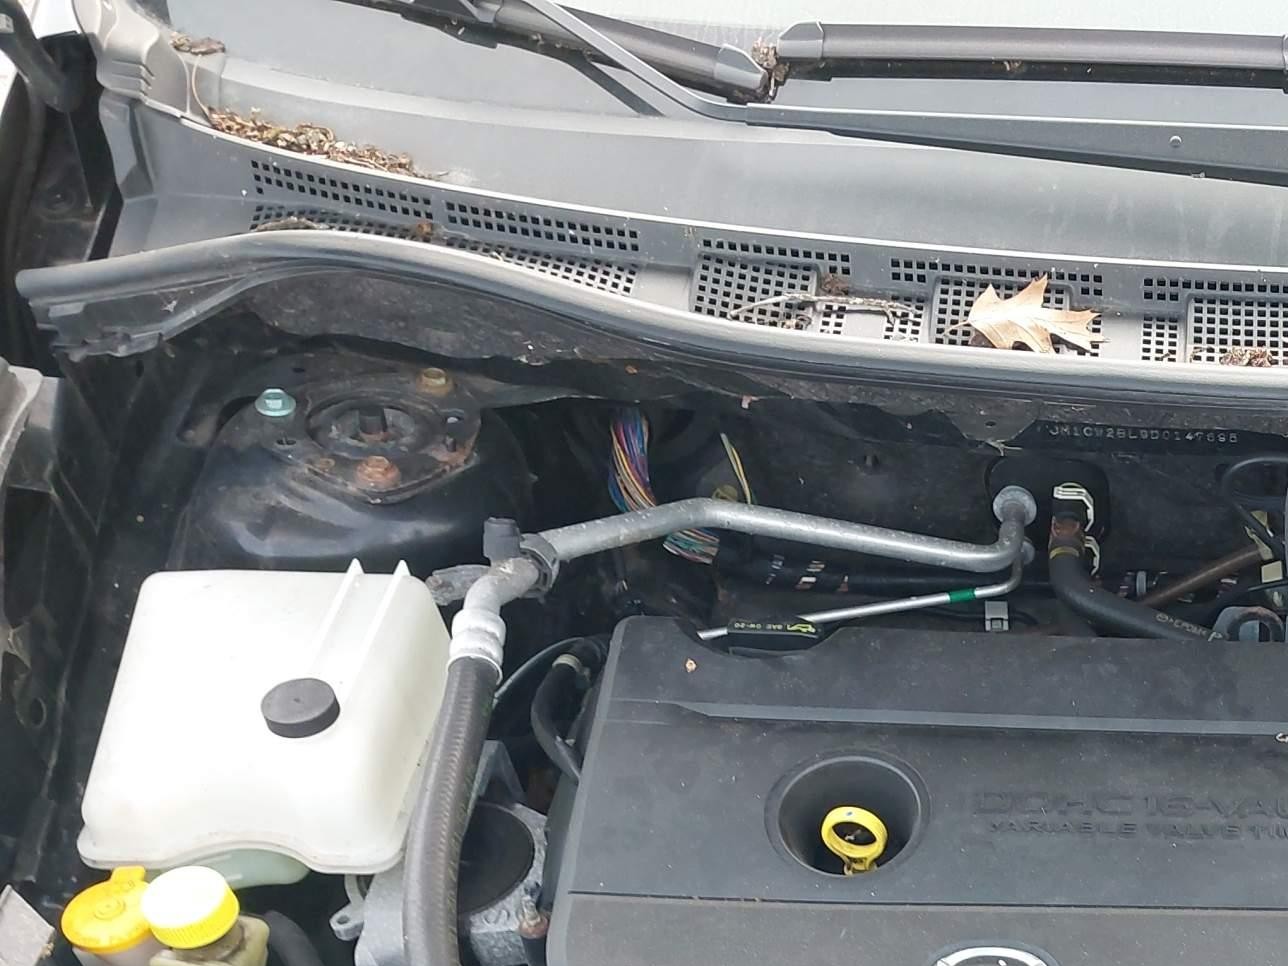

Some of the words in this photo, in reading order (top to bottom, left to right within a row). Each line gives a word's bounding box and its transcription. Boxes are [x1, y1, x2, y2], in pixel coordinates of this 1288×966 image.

[974, 793, 1134, 816] DOHC
[988, 819, 1137, 836] VARIABLE
[1147, 821, 1241, 840] VALVE
